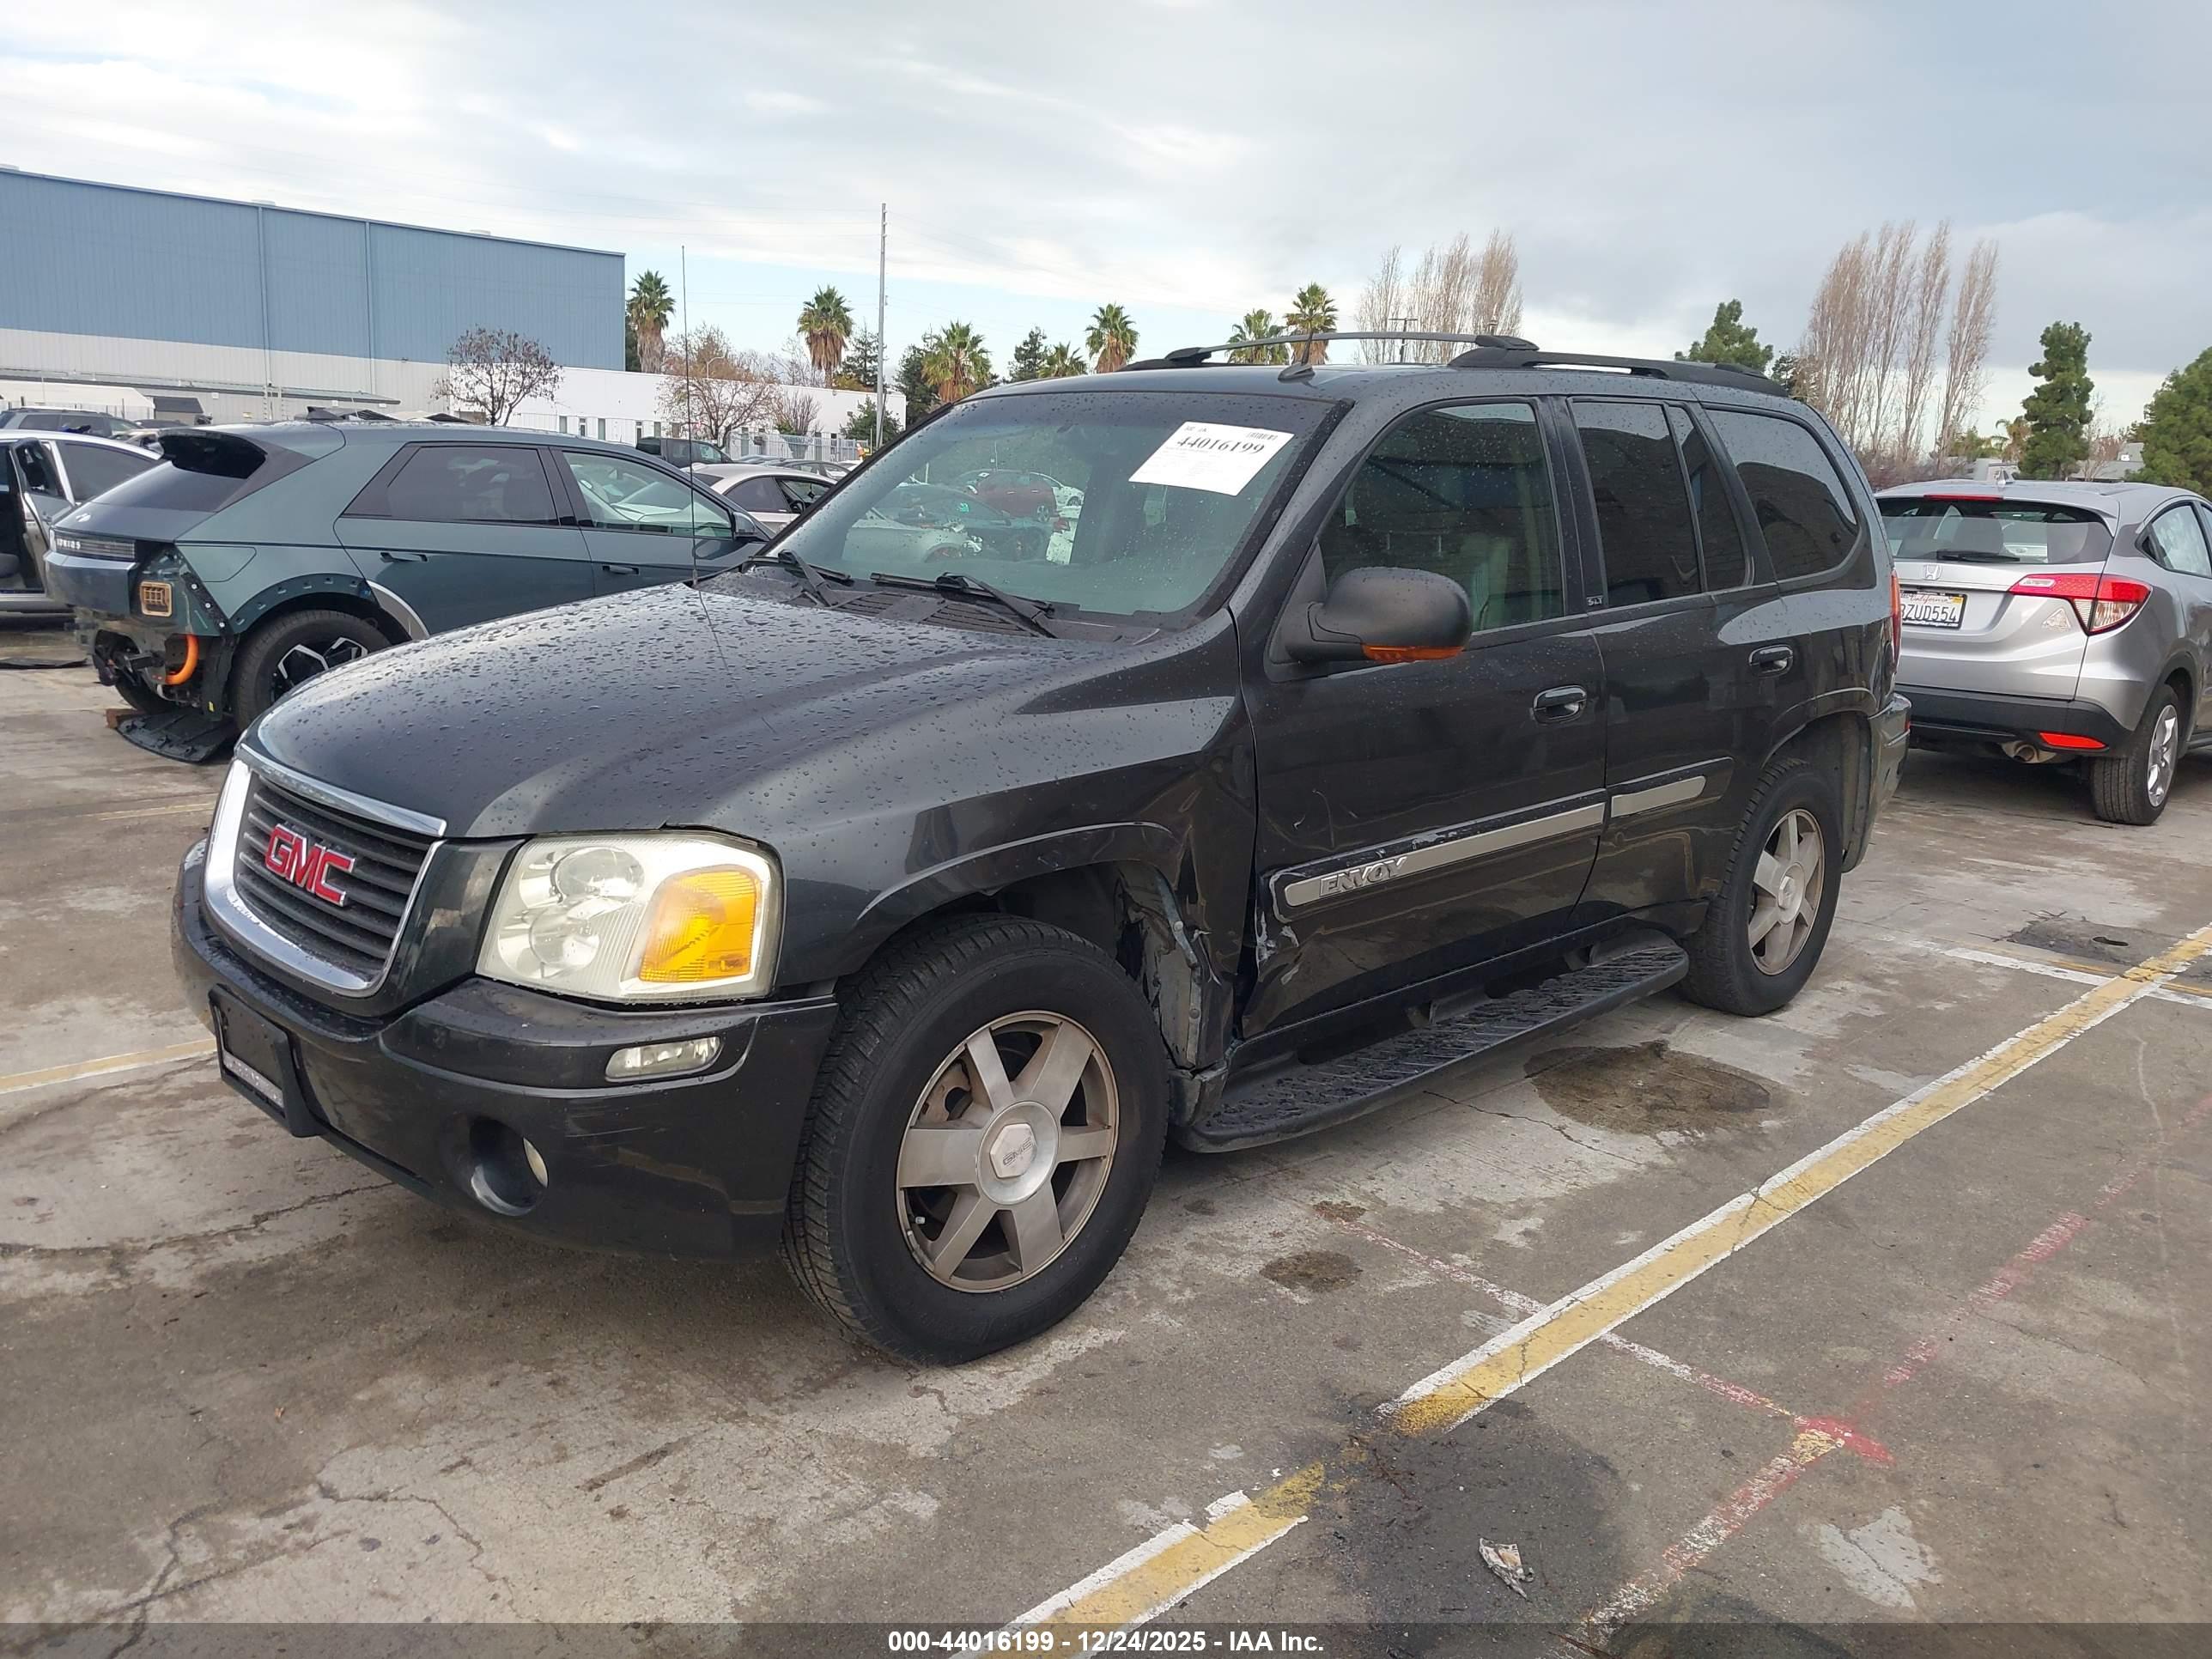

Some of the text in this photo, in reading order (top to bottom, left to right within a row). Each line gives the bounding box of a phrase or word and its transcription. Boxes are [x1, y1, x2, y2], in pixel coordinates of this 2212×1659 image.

[1177, 436, 1265, 454] 44016199
[265, 823, 356, 907] GMC
[1319, 856, 1408, 897] ENVOY
